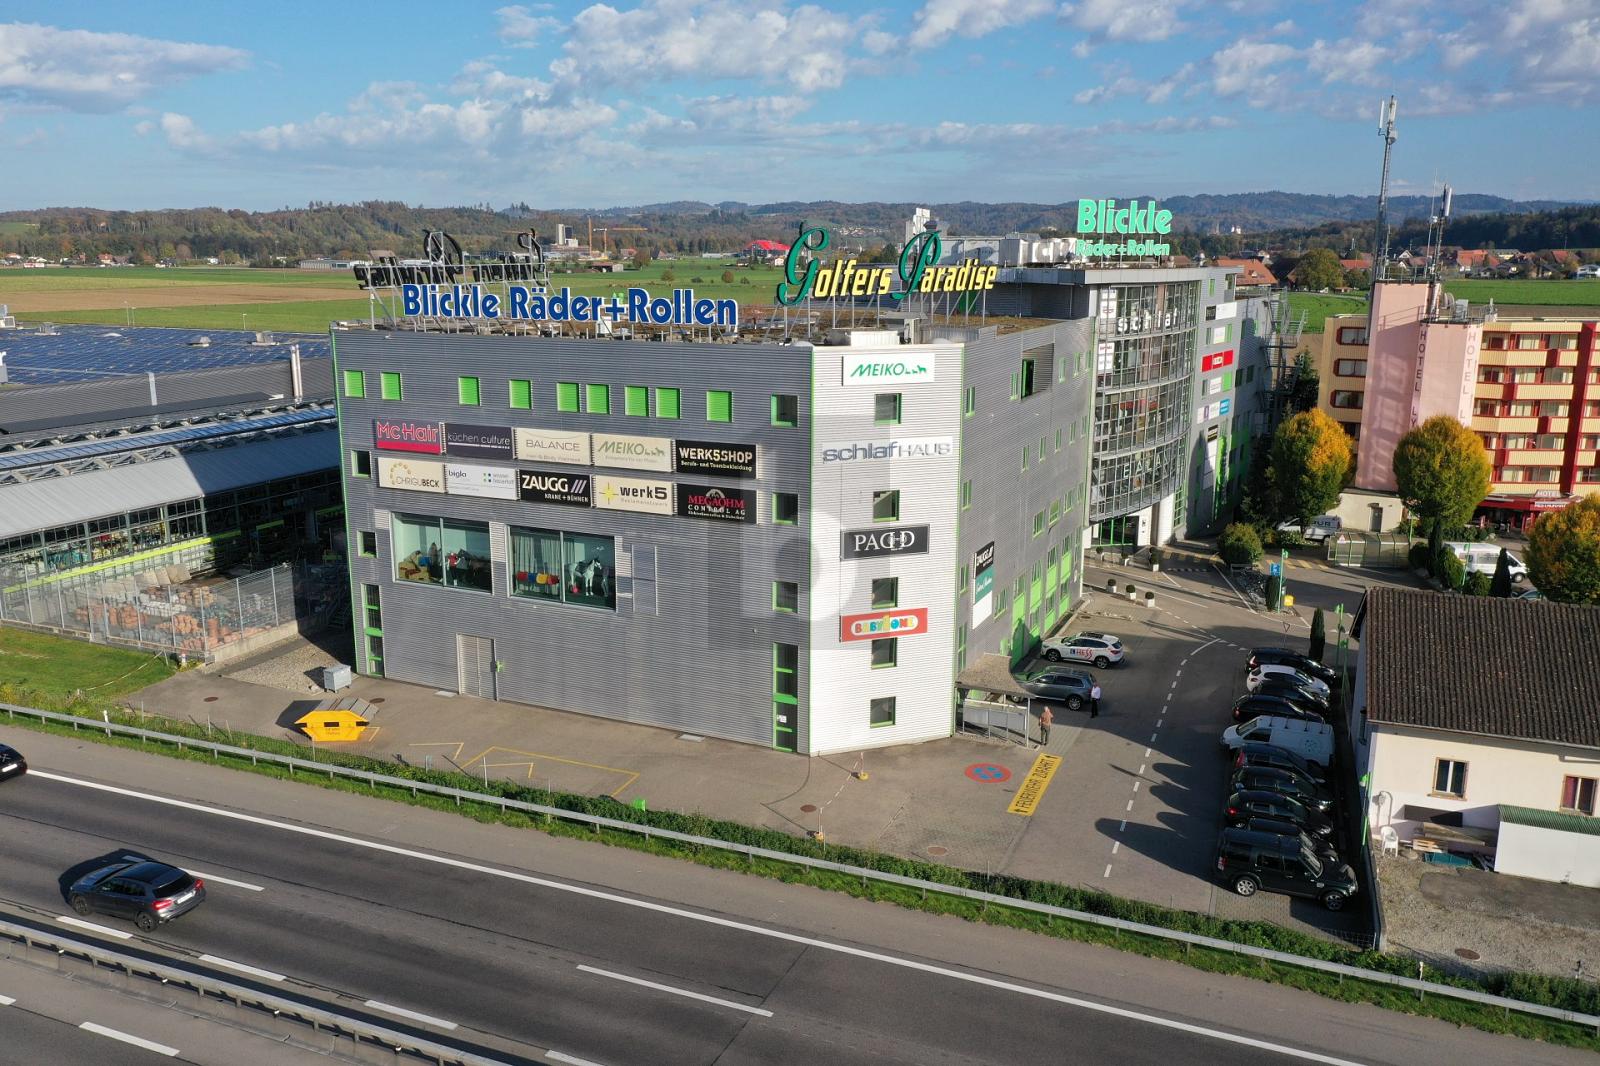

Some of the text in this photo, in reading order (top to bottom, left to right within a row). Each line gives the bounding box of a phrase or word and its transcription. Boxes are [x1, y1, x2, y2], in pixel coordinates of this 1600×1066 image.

[1077, 198, 1173, 235] Blickle
[777, 221, 998, 306] Golfers Paradise
[402, 283, 738, 328] Blickle Räder+Rollen
[1415, 330, 1428, 392] HOTEL
[1462, 331, 1477, 395] HOTEL
[851, 363, 905, 377] MEIKO
[481, 434, 510, 446] culture
[525, 439, 581, 452] BALANCE
[598, 440, 645, 455] MEIKO
[521, 475, 569, 493] ZAUGG
[544, 493, 562, 501] KRANE
[567, 494, 589, 503] BÜHNEN
[620, 486, 668, 500] werk5
[687, 504, 731, 514] CONTROL
[688, 495, 746, 509] MEGAOHM
